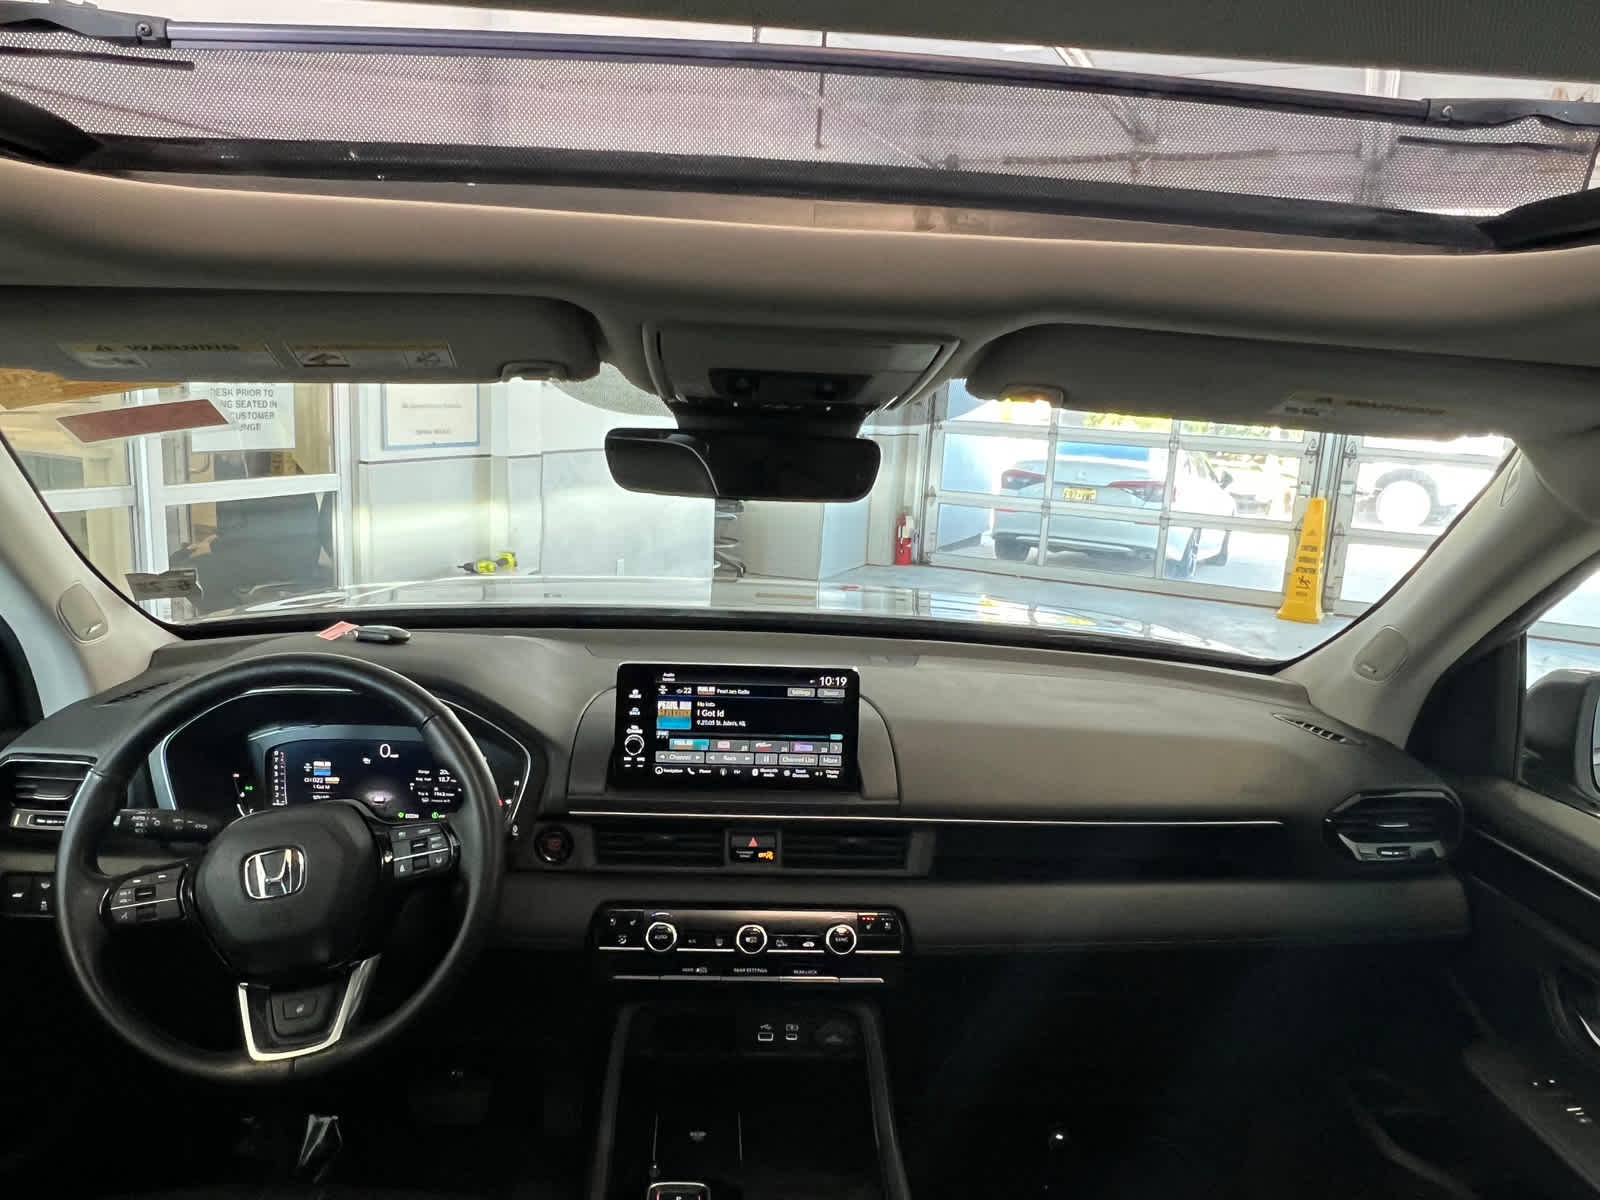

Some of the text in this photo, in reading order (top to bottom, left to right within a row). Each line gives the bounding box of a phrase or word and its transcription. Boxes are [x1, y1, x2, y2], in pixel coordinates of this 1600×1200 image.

[236, 388, 262, 398] PRIOR
[263, 388, 274, 398] TO
[235, 400, 268, 409] SEATED
[269, 400, 278, 409] IN
[819, 676, 848, 687] 10:19
[701, 709, 716, 718] Got
[379, 743, 391, 758] 0
